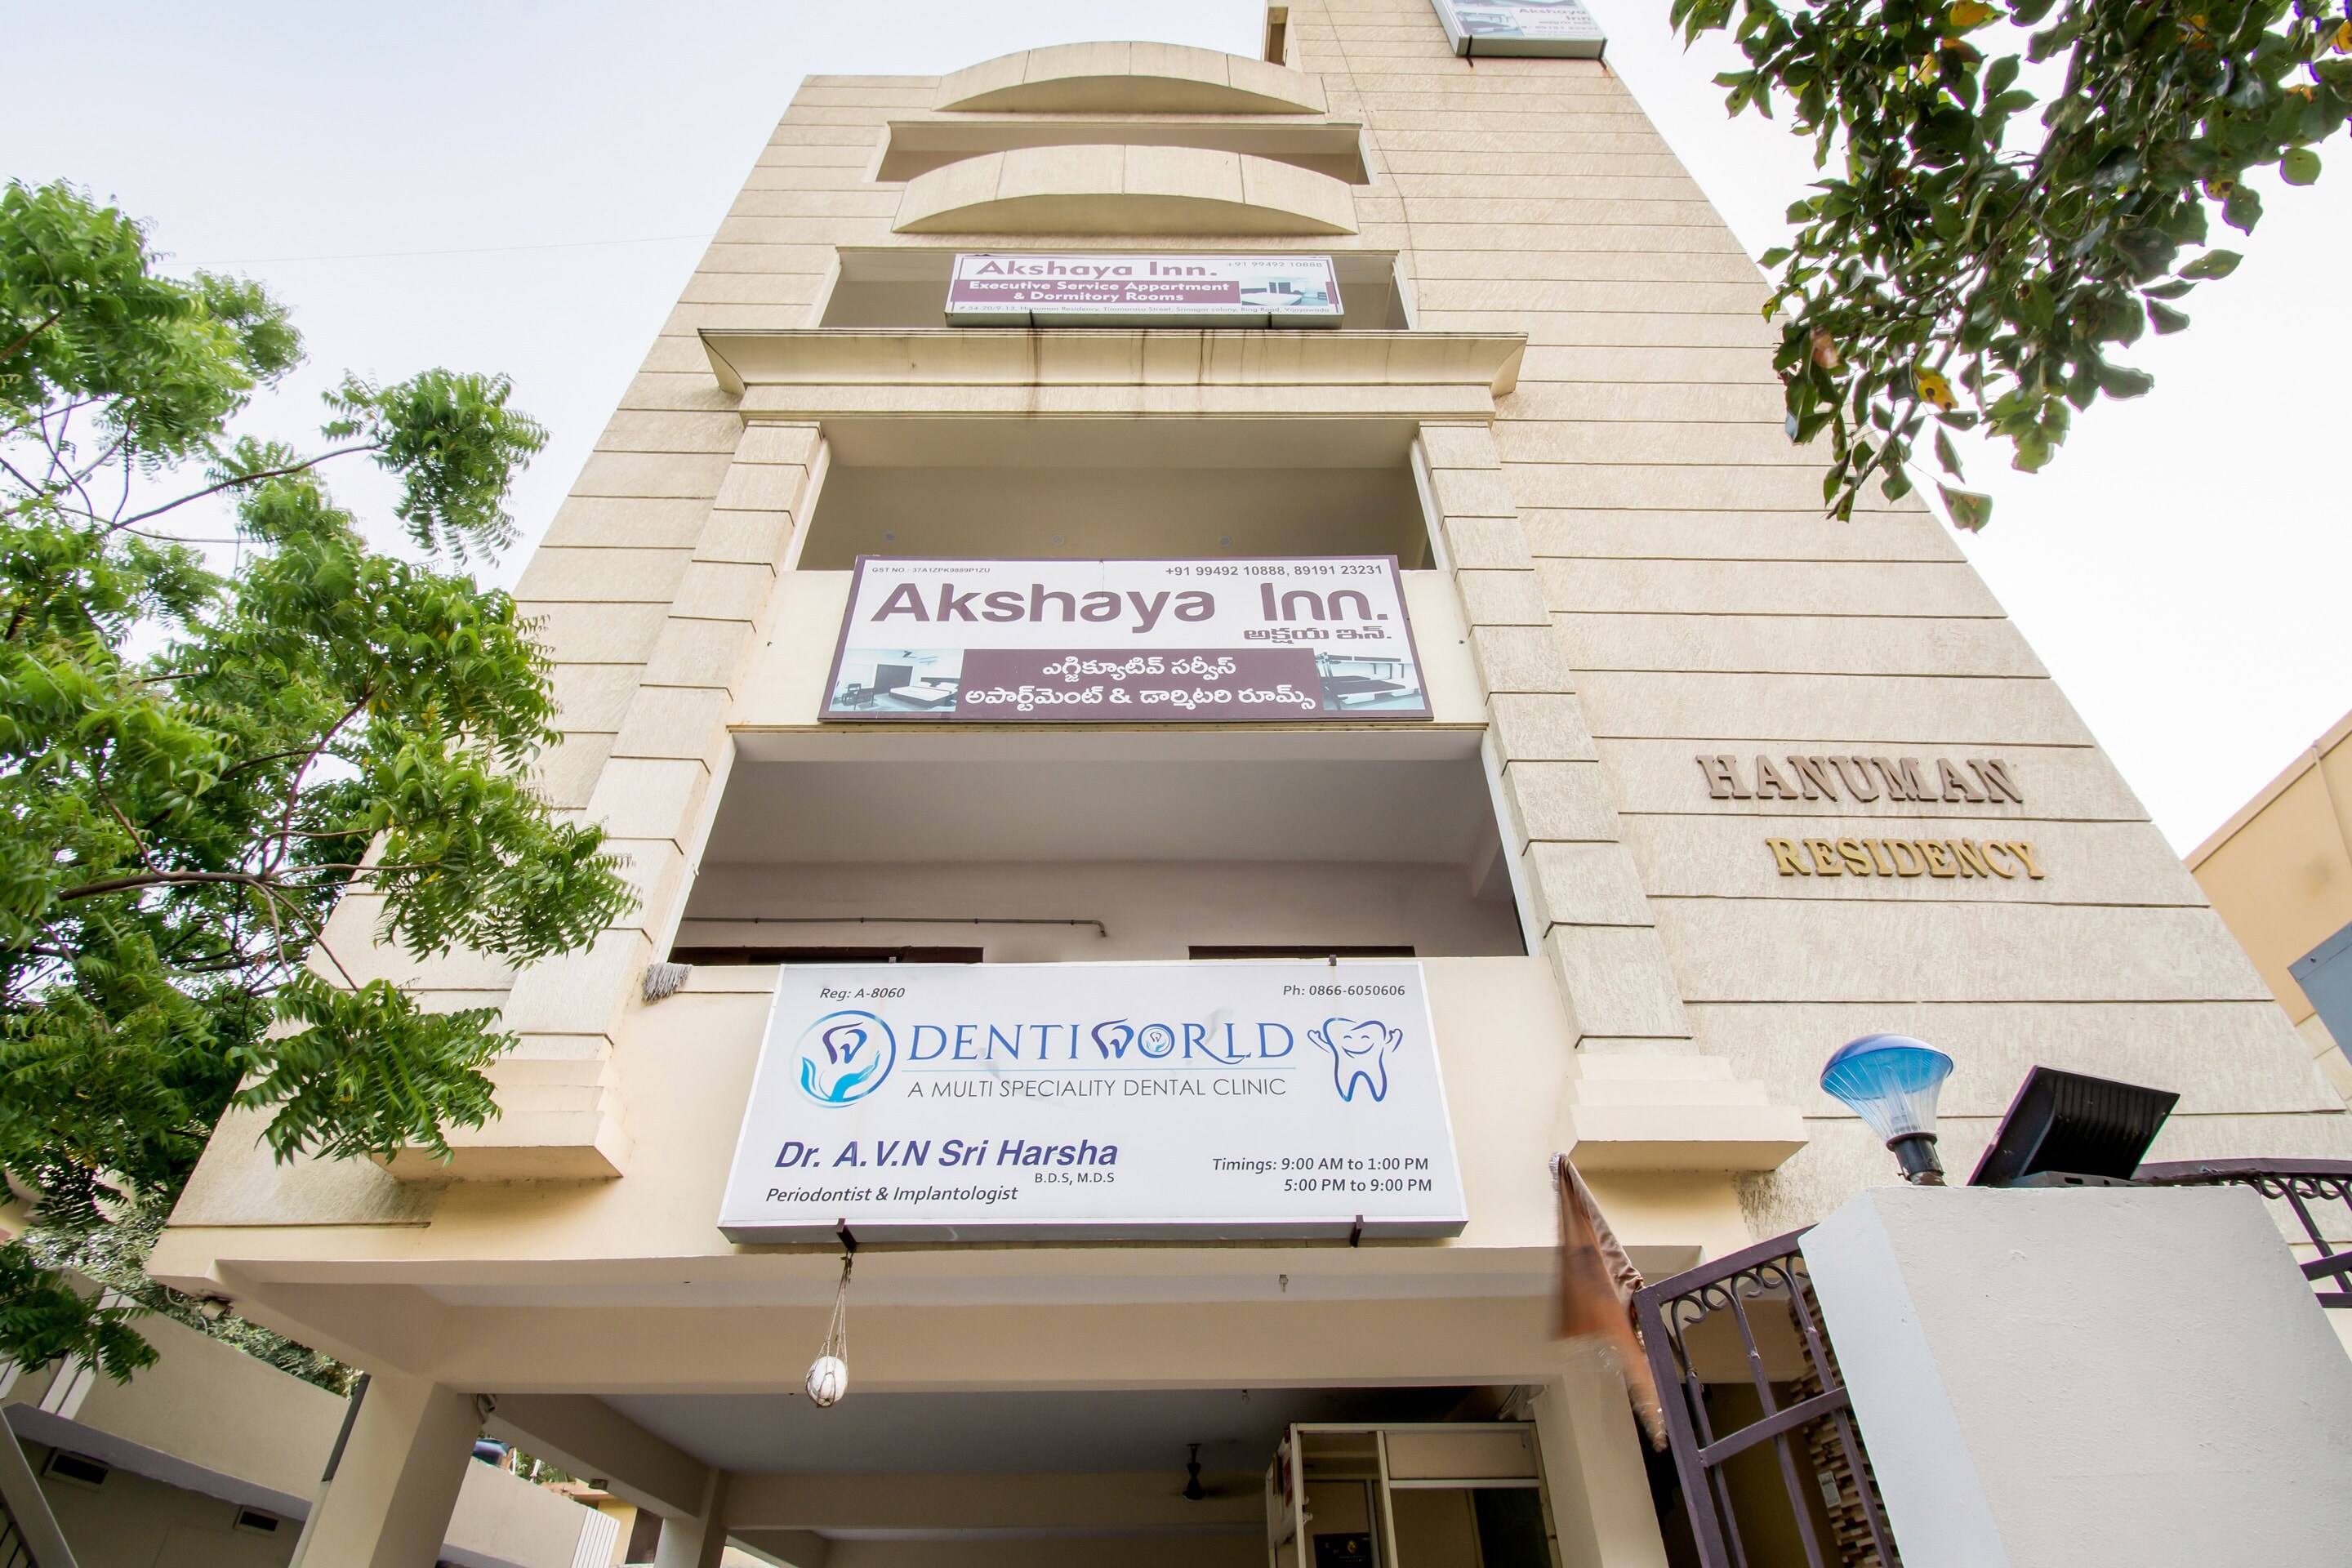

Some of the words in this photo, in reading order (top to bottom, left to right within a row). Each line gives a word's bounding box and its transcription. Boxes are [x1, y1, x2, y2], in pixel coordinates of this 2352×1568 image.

[975, 260, 1133, 279] Akshaya
[1149, 261, 1218, 276] Inn.
[969, 281, 1051, 291] Executive
[1057, 281, 1119, 291] Service
[1124, 281, 1229, 293] Appartment
[1013, 292, 1025, 301] &
[1030, 292, 1121, 303] Dormitory
[1125, 292, 1184, 301] Rooms
[1165, 567, 1191, 576] +91
[1196, 566, 1239, 576] 99492
[1243, 565, 1290, 577] 10888,
[1294, 565, 1337, 575] 89191
[1341, 565, 1383, 574] 23231
[870, 582, 1216, 634] Akshaya
[1259, 582, 1389, 621] Inn.
[1109, 689, 1133, 704] &
[1696, 755, 2024, 803] HANUMAN
[1766, 837, 2044, 880] RESIDENCY
[819, 988, 852, 1000] Reg:
[854, 987, 906, 998] A-8060
[1283, 986, 1305, 996] Ph:
[1309, 985, 1405, 996] 0866-6050606
[907, 1018, 1294, 1065] DENTIWORLD
[907, 1082, 924, 1098] A
[931, 1080, 992, 1097] MULTI
[1000, 1080, 1116, 1097] SPECIALITY
[1124, 1080, 1205, 1096] DENTAL
[1213, 1078, 1287, 1095] CLINIC
[774, 1142, 820, 1167] Dr.
[833, 1141, 931, 1167] A.V.N
[938, 1140, 987, 1166] Sri
[996, 1139, 1118, 1166] Harsha
[1213, 1157, 1278, 1173] Timings:
[1281, 1158, 1314, 1170] 9:00
[1318, 1158, 1343, 1170] AM
[1348, 1158, 1364, 1170] to
[1368, 1158, 1401, 1170] 1:00
[1405, 1158, 1429, 1170] PM
[1034, 1173, 1074, 1186] B.D.S,
[1077, 1173, 1115, 1183] M.D.S
[1284, 1178, 1317, 1192] 5:00
[1321, 1179, 1346, 1192] PM
[1350, 1180, 1366, 1192] to
[1370, 1179, 1403, 1192] 9:00
[1407, 1179, 1432, 1191] PM
[766, 1187, 871, 1202] Periodontist
[875, 1187, 889, 1200] &
[893, 1186, 1018, 1204] Implantologist
